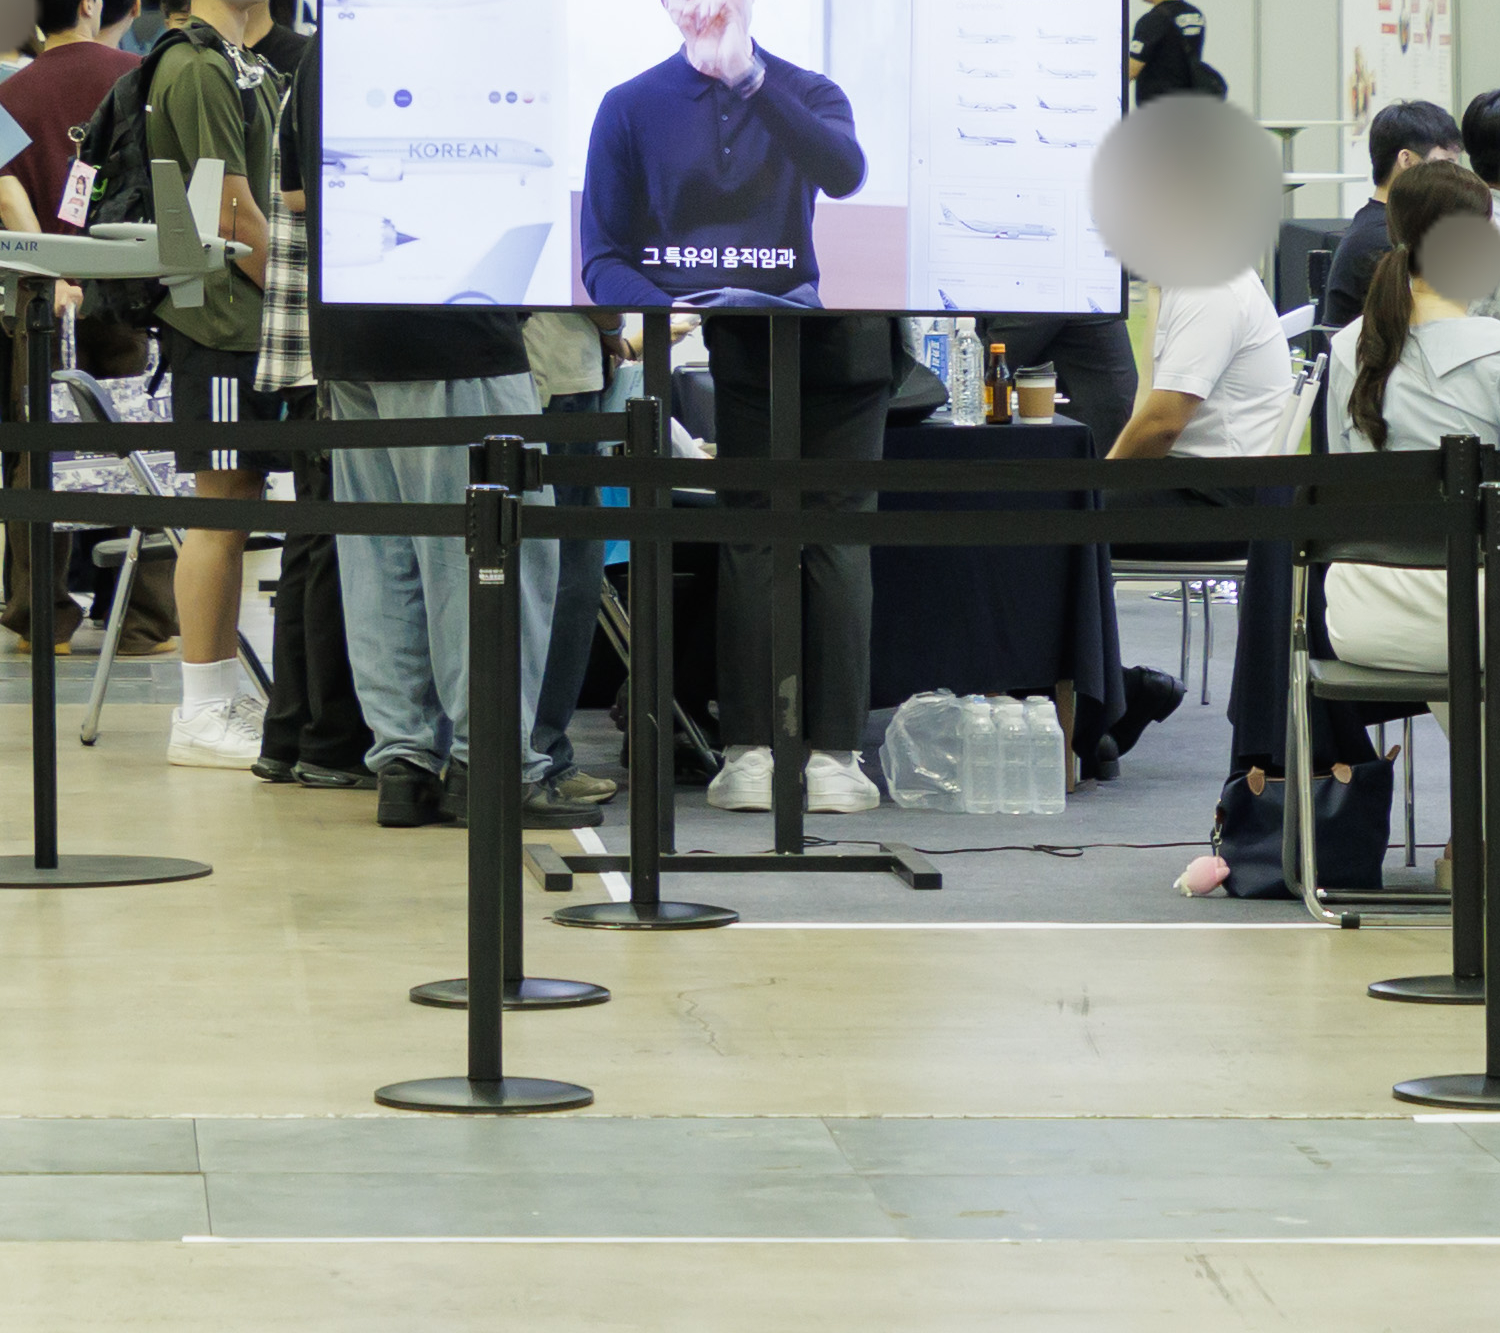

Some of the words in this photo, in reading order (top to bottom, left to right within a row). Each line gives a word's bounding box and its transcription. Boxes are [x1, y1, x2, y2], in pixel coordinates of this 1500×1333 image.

[409, 142, 499, 158] KOREAN
[13, 239, 38, 252] AIR
[641, 247, 662, 265] 그
[664, 246, 718, 268] 특유의
[720, 246, 797, 269] 움직임과
